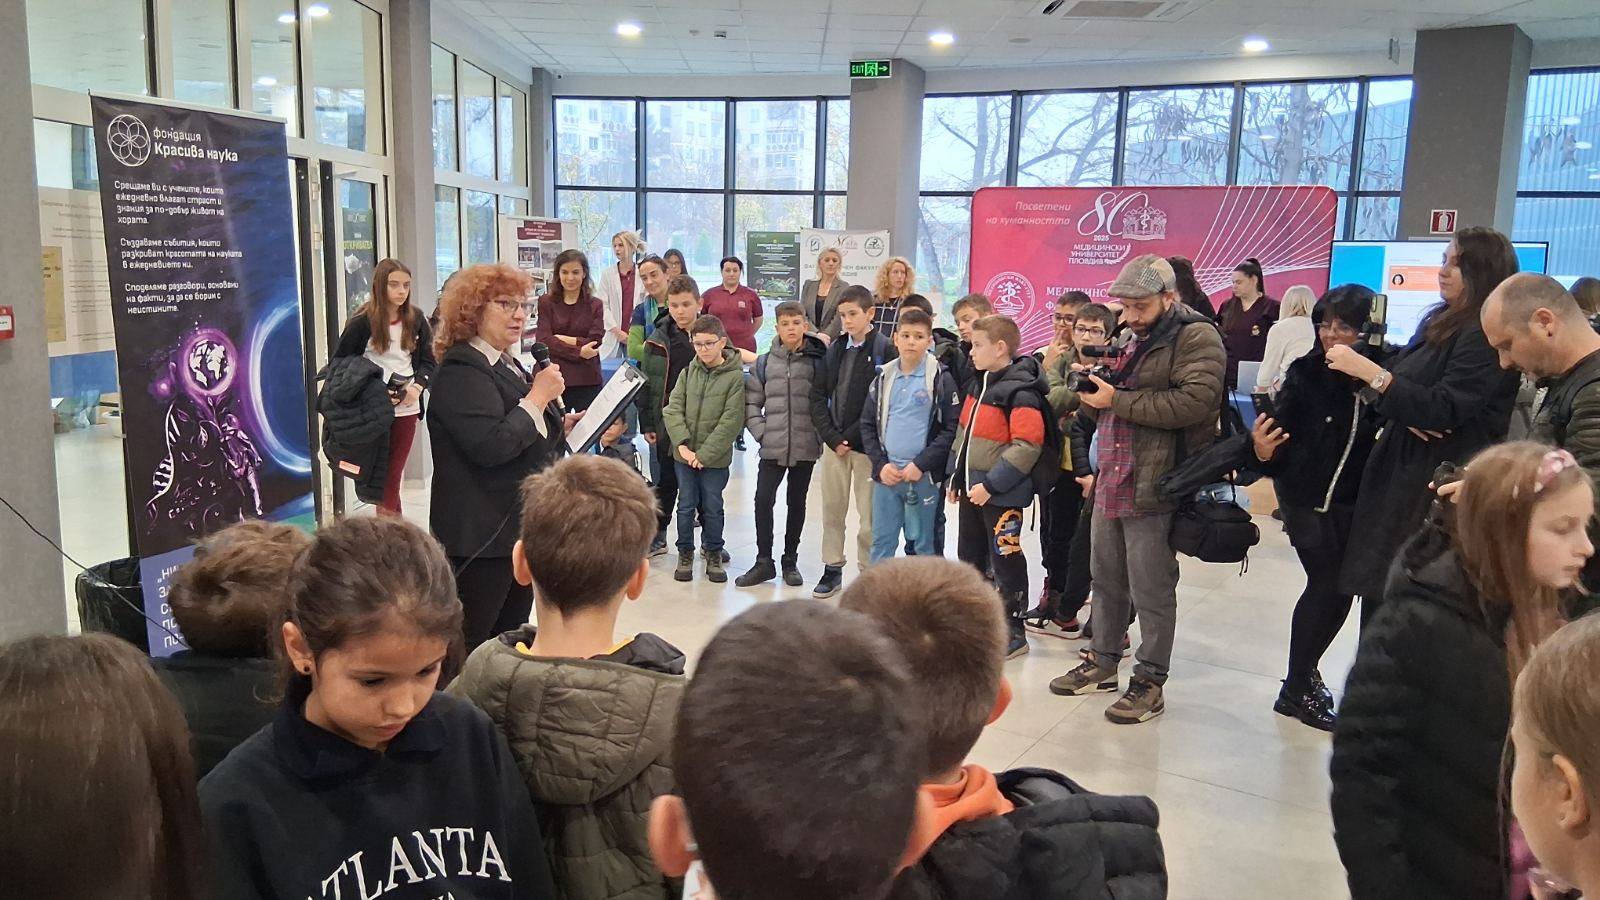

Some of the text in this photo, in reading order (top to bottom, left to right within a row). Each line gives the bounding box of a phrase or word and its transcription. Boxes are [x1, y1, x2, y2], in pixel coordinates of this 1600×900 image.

[852, 65, 865, 74] EXIT
[153, 127, 201, 142] фондация
[154, 142, 238, 163] Красива наука
[114, 180, 151, 191] Срещаме
[152, 182, 161, 191] ви
[203, 185, 224, 195] които
[115, 192, 158, 203] ежедневно
[160, 194, 186, 203] влагат
[187, 198, 217, 206] страст
[116, 205, 225, 216] знания за по-добър живот на
[1015, 201, 1072, 211] Посветени
[117, 216, 149, 225] хората.
[985, 217, 1071, 227] на хуманността
[120, 238, 221, 248] Създаваме събития, които
[1073, 244, 1126, 252] МЕДИЦИНСКИ
[121, 249, 243, 260] разкриват красотата на науката
[122, 261, 128, 269] в
[129, 260, 181, 271] ежедневието
[125, 280, 239, 293] Споделяме разговори, основани
[126, 295, 136, 303] на
[137, 293, 166, 304] факти,
[166, 294, 175, 303] за
[176, 294, 184, 303] да
[194, 292, 216, 302] борим
[127, 305, 179, 314] неистините.
[306, 826, 513, 900] TLANTA
